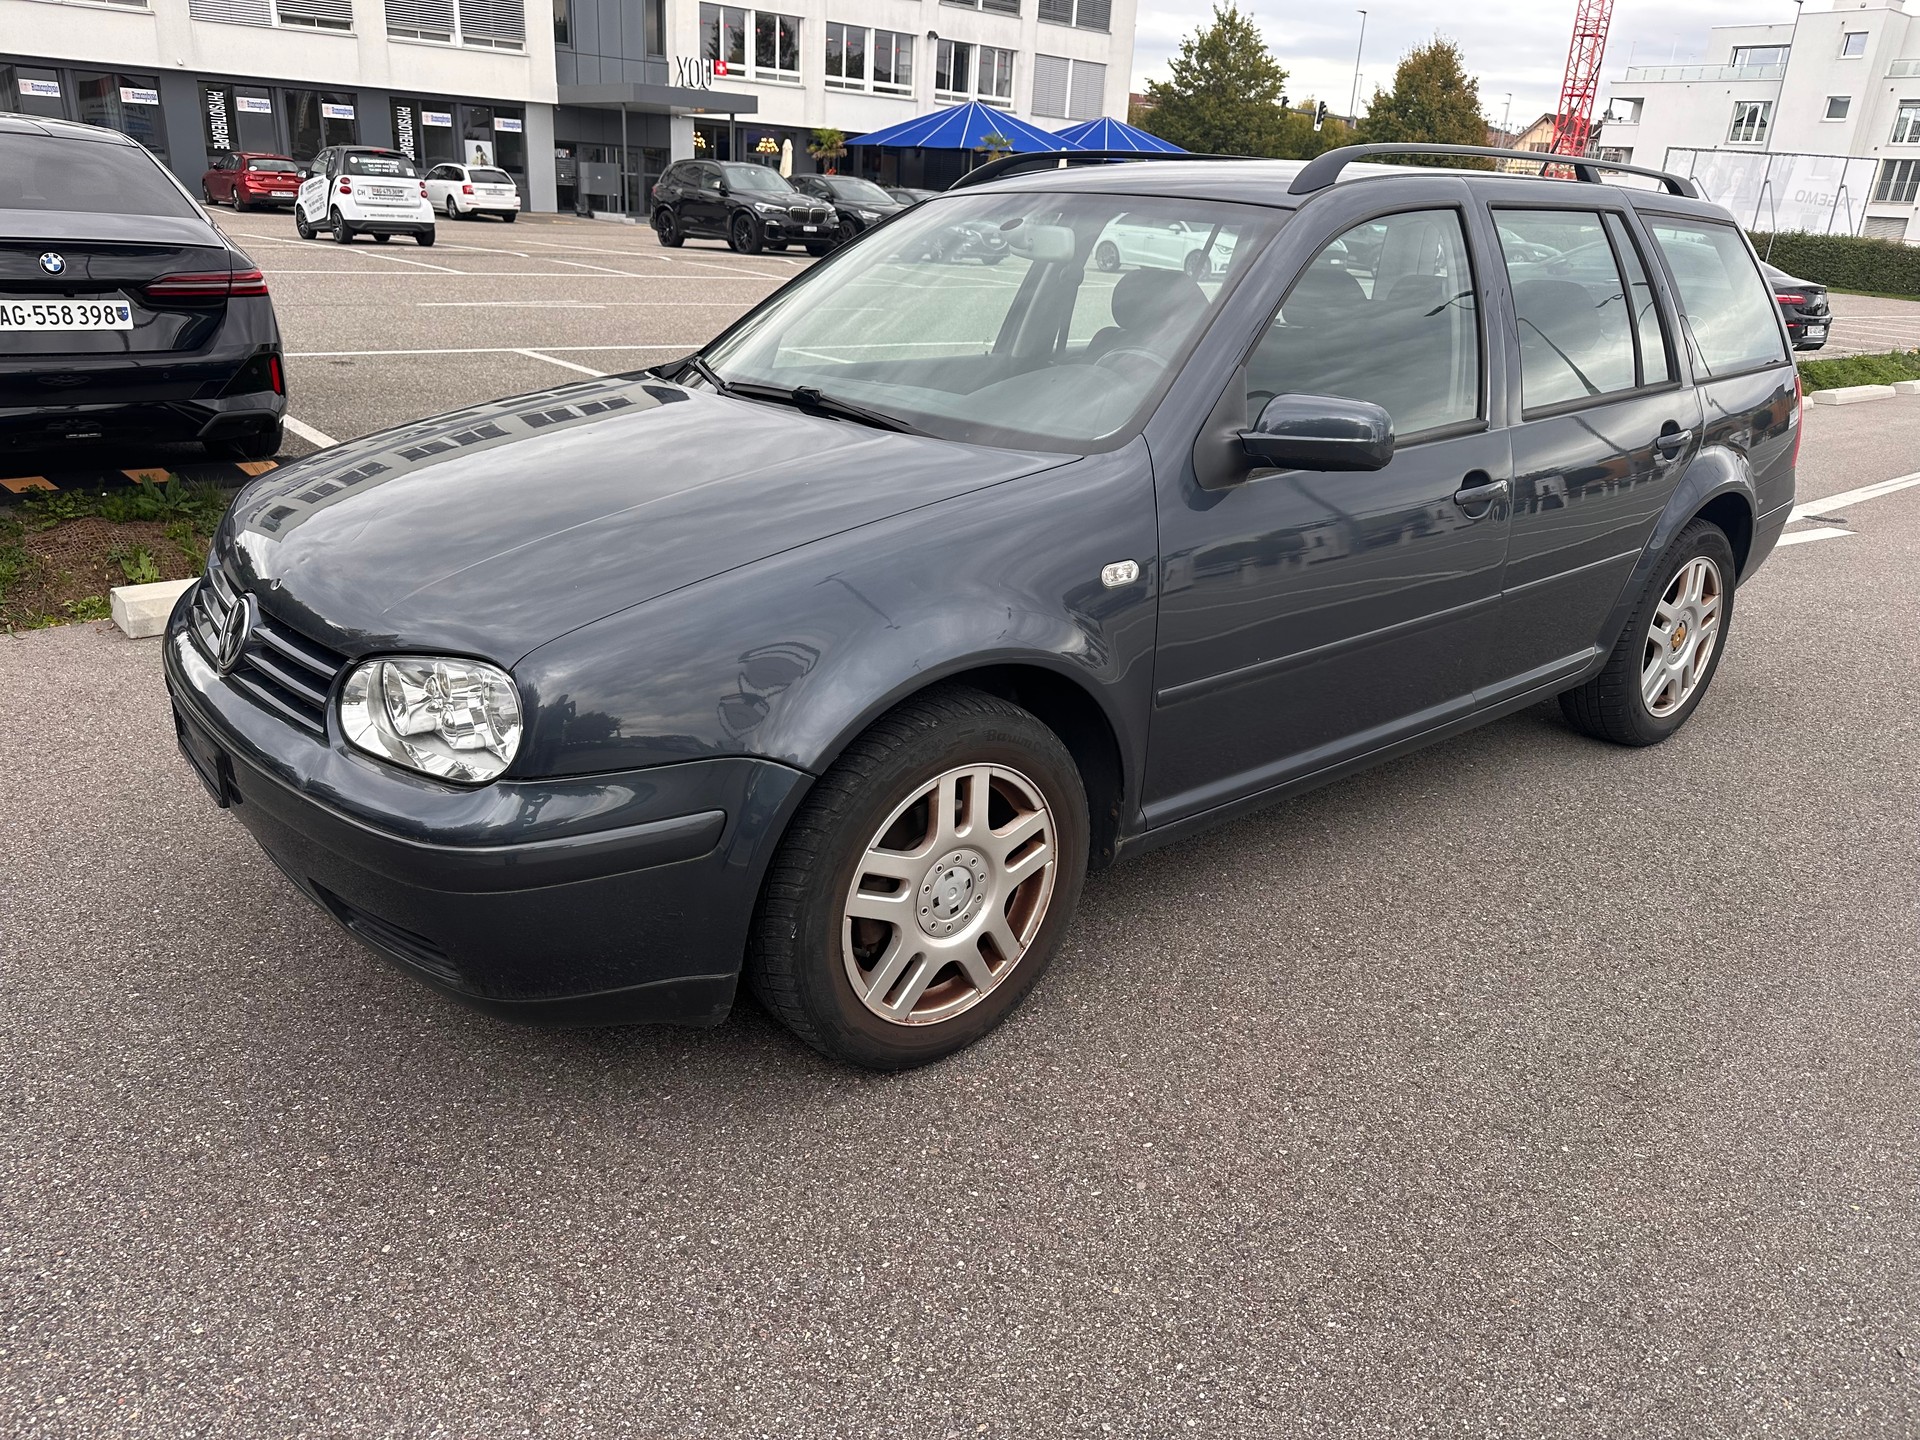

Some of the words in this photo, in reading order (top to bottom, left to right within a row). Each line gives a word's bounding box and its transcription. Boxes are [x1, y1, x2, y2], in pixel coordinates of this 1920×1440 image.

[676, 56, 712, 90] YOU
[207, 90, 230, 149] PHYSIOTHERAPIE
[76, 305, 116, 326] 398
